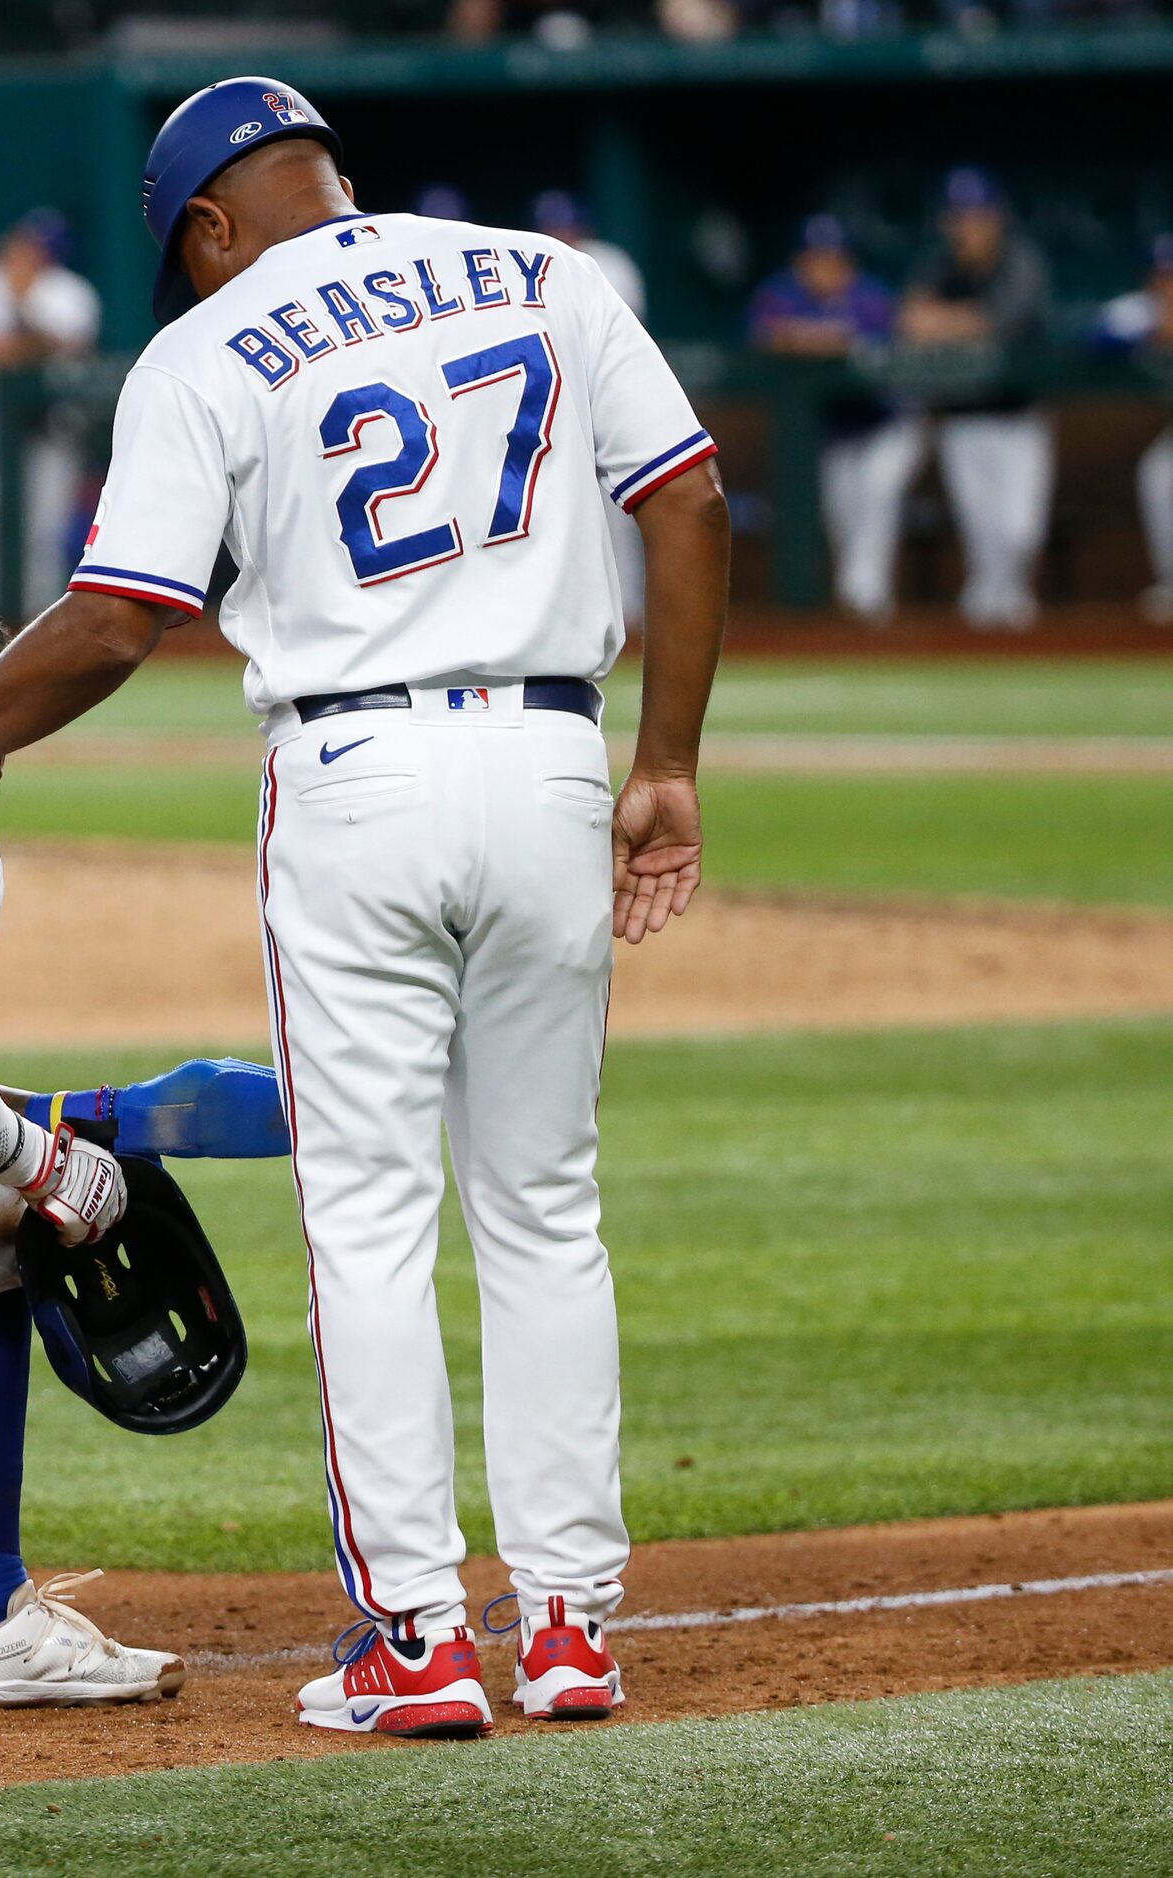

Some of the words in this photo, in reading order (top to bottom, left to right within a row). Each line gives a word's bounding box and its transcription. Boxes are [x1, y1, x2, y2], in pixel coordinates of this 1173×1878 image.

[262, 92, 294, 112] 27
[221, 247, 554, 392] BEASLEY
[317, 329, 562, 588] 27
